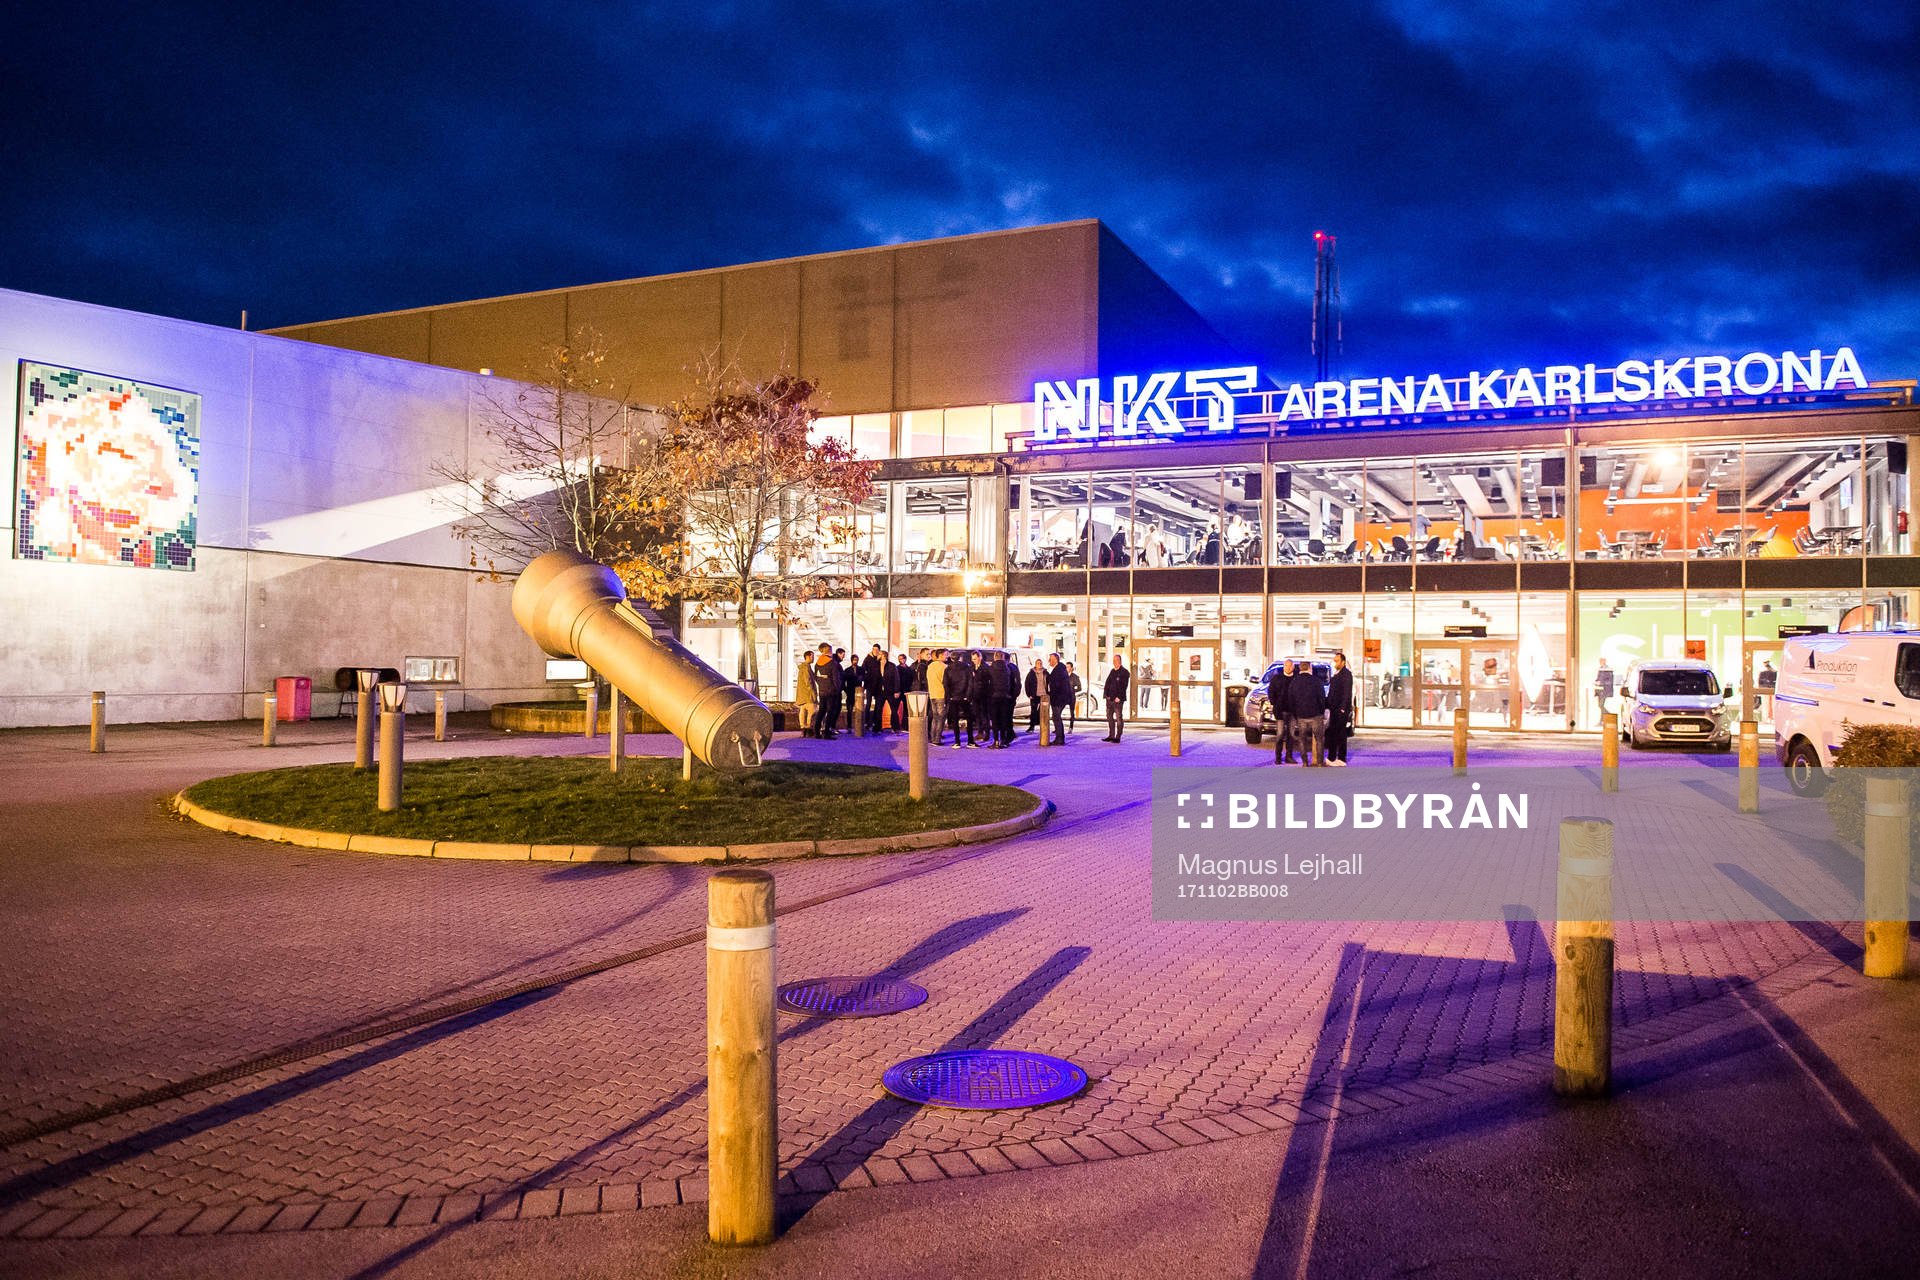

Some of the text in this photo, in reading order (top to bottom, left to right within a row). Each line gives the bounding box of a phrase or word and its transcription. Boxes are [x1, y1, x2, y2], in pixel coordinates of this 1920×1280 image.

[1034, 346, 1869, 440] NKT ARENA KARLSKRONA
